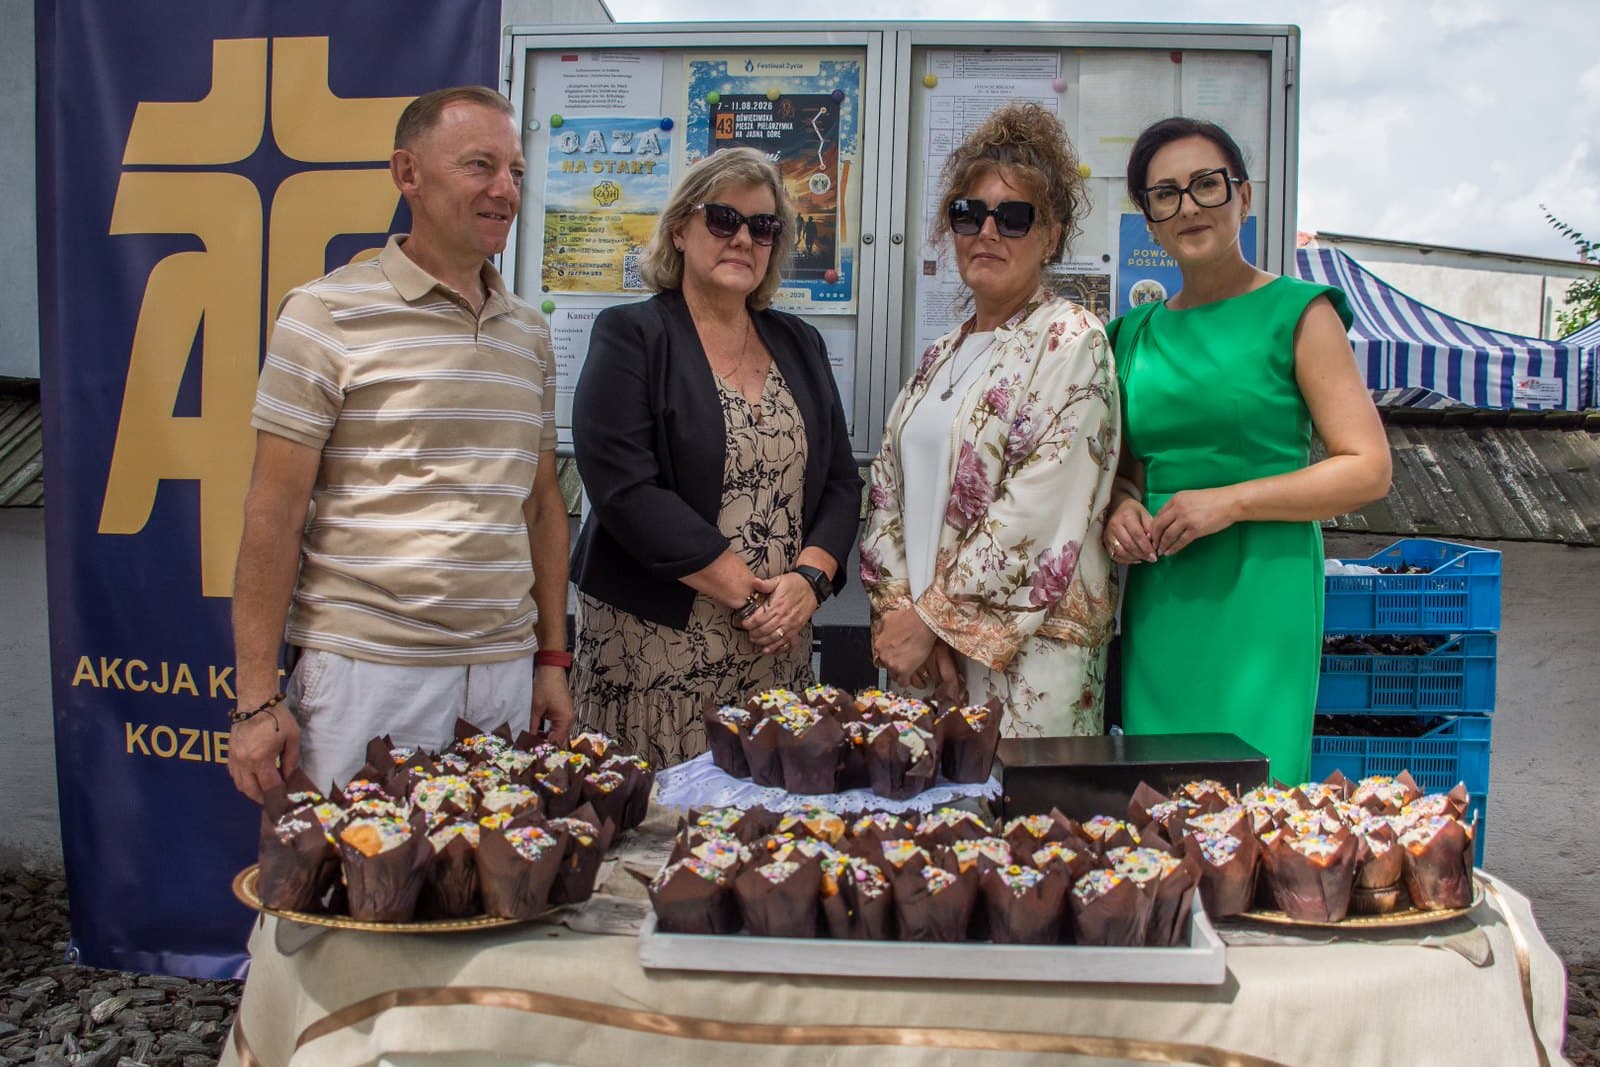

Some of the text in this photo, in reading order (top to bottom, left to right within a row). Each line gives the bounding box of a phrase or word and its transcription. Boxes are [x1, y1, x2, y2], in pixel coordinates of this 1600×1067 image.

[716, 118, 733, 134] 43
[735, 122, 754, 130] PIESZA
[558, 130, 662, 155] OAZA
[561, 160, 657, 175] NA START
[1133, 249, 1168, 257] POWO
[72, 655, 199, 697] AKCJA
[125, 722, 231, 765] KOZIE
